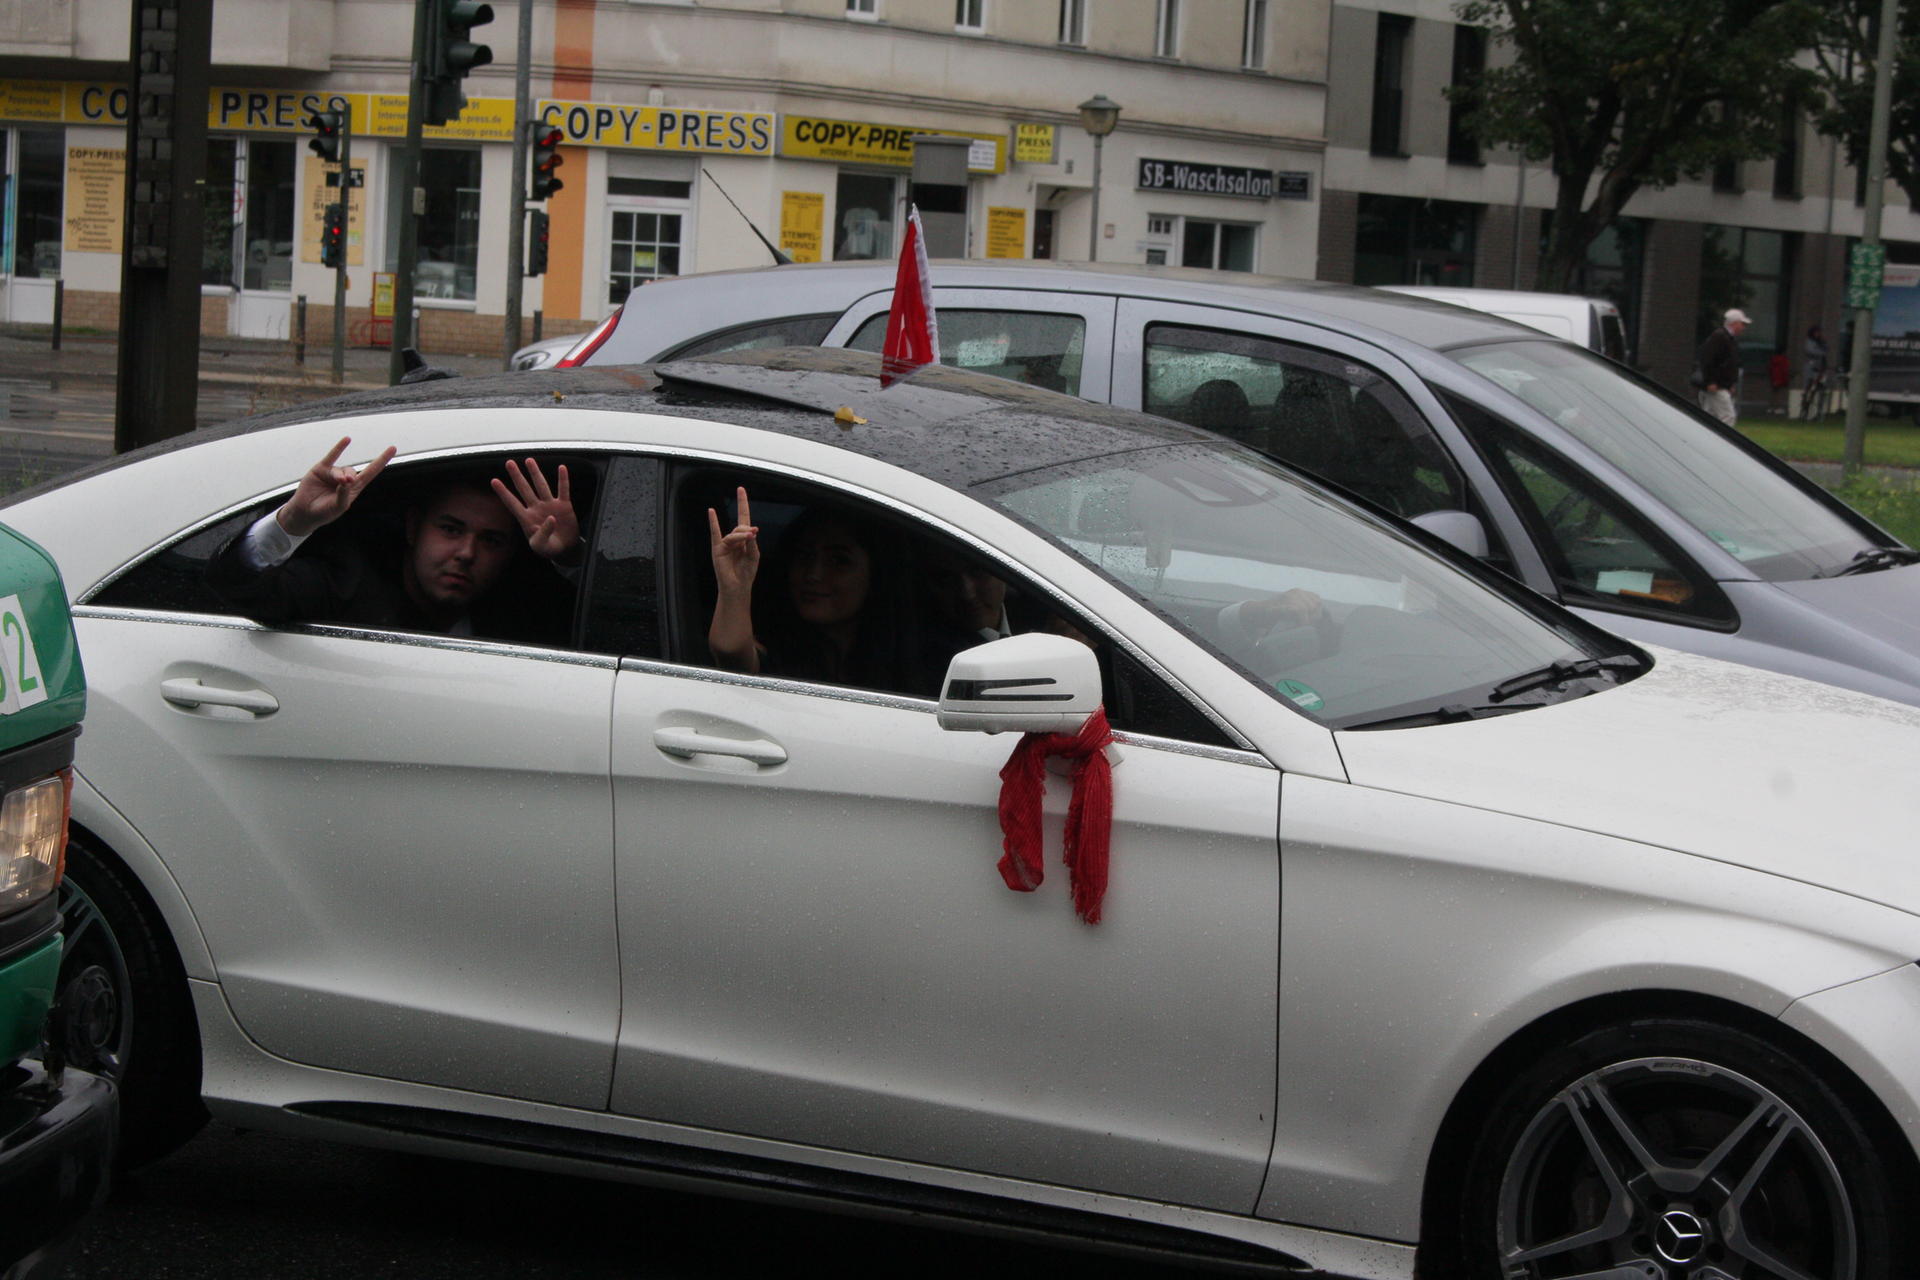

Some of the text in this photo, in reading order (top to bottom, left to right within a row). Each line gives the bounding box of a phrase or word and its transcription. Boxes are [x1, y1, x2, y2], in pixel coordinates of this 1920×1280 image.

[795, 120, 942, 151] COPY-PRE
[1018, 137, 1051, 147] PRESS
[1141, 161, 1272, 197] SB-Waschsalon
